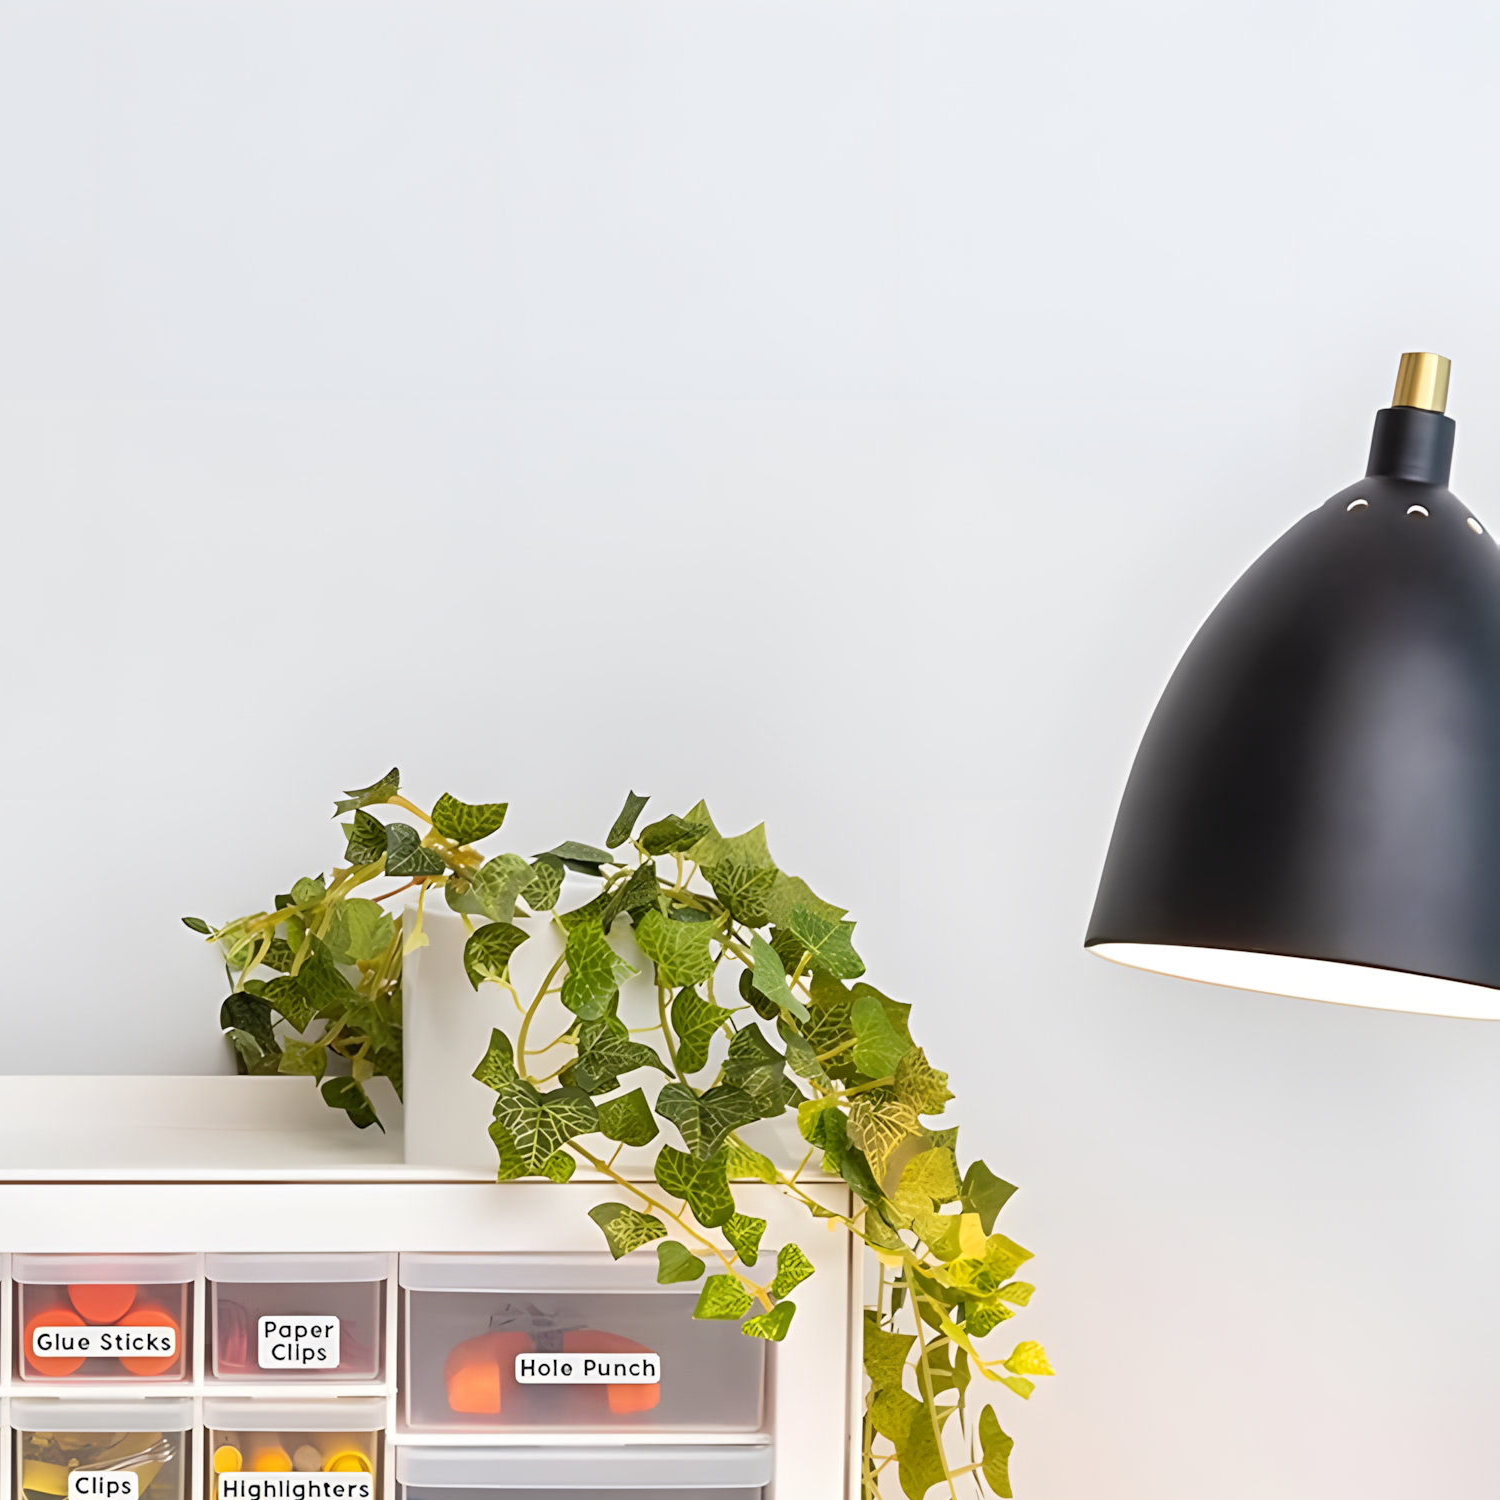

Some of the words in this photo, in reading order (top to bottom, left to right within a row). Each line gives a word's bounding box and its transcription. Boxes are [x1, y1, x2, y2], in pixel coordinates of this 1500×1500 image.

[37, 1333, 90, 1351] Glue
[100, 1333, 171, 1351] Sticks
[264, 1321, 334, 1342] Paper
[271, 1343, 327, 1365] Clips
[521, 1359, 573, 1377] Hole
[584, 1359, 655, 1377] Punch
[75, 1476, 131, 1498] Clips
